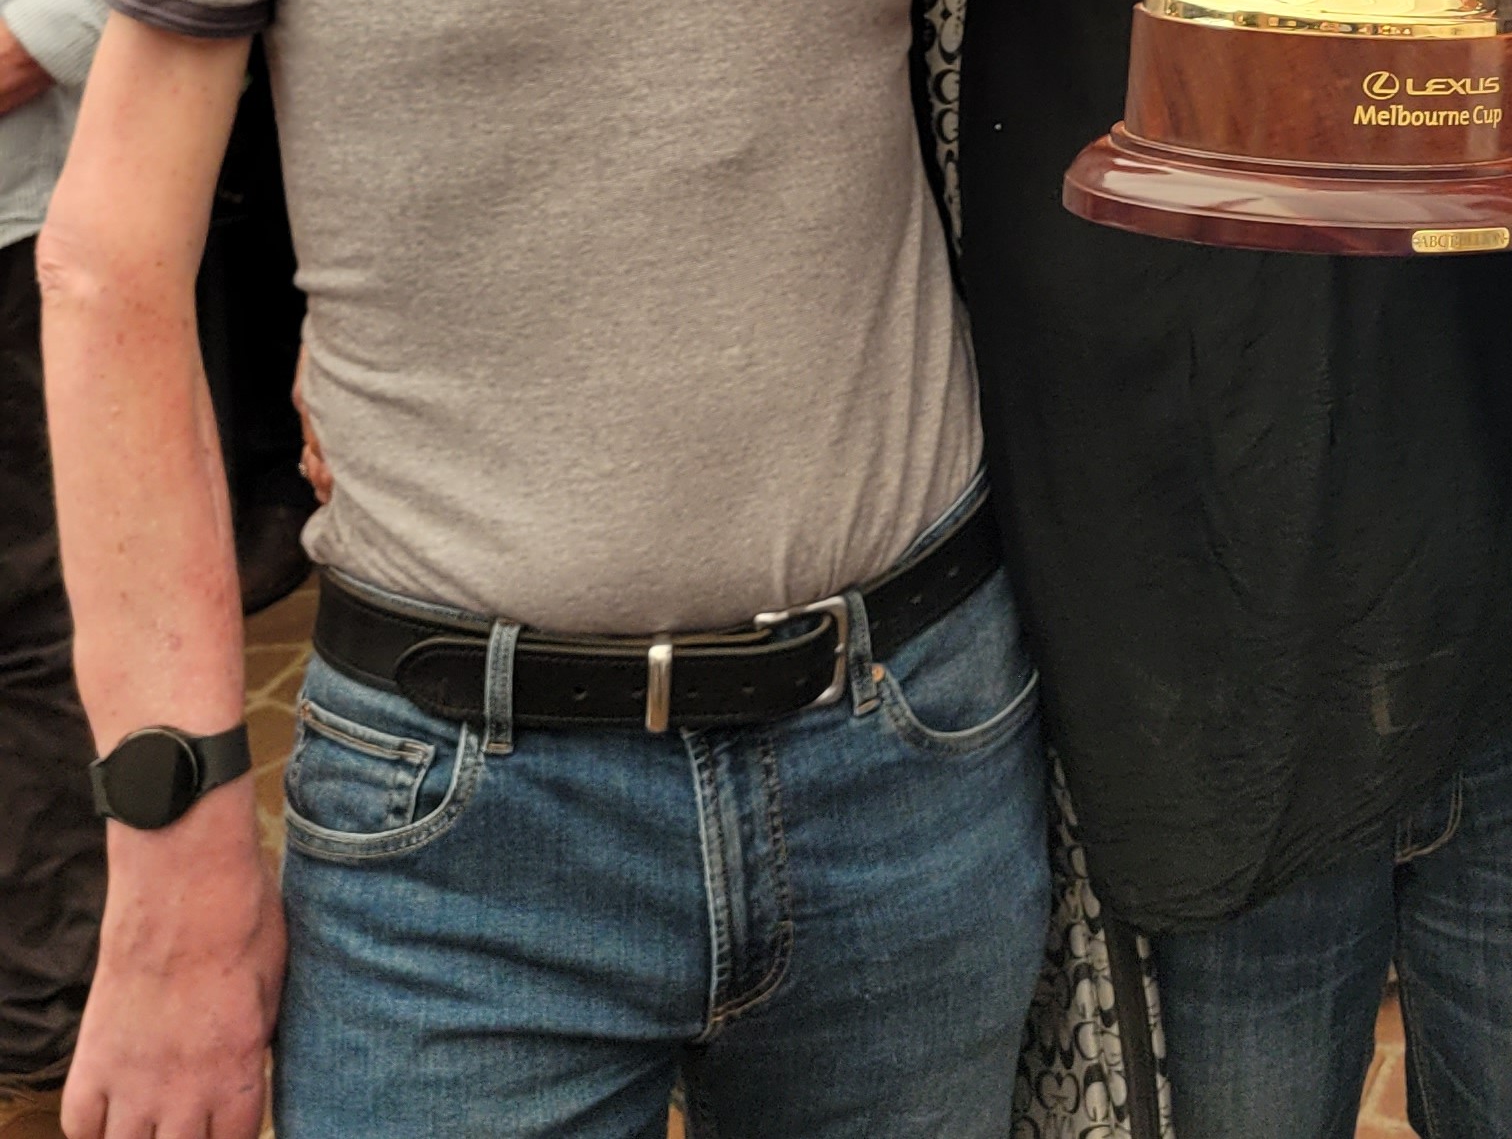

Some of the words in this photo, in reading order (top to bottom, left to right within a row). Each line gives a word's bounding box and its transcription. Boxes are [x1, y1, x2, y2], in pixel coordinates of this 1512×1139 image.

[1406, 76, 1500, 96] LEXUS
[1353, 105, 1469, 127] Melbourne
[1472, 105, 1502, 129] Cup
